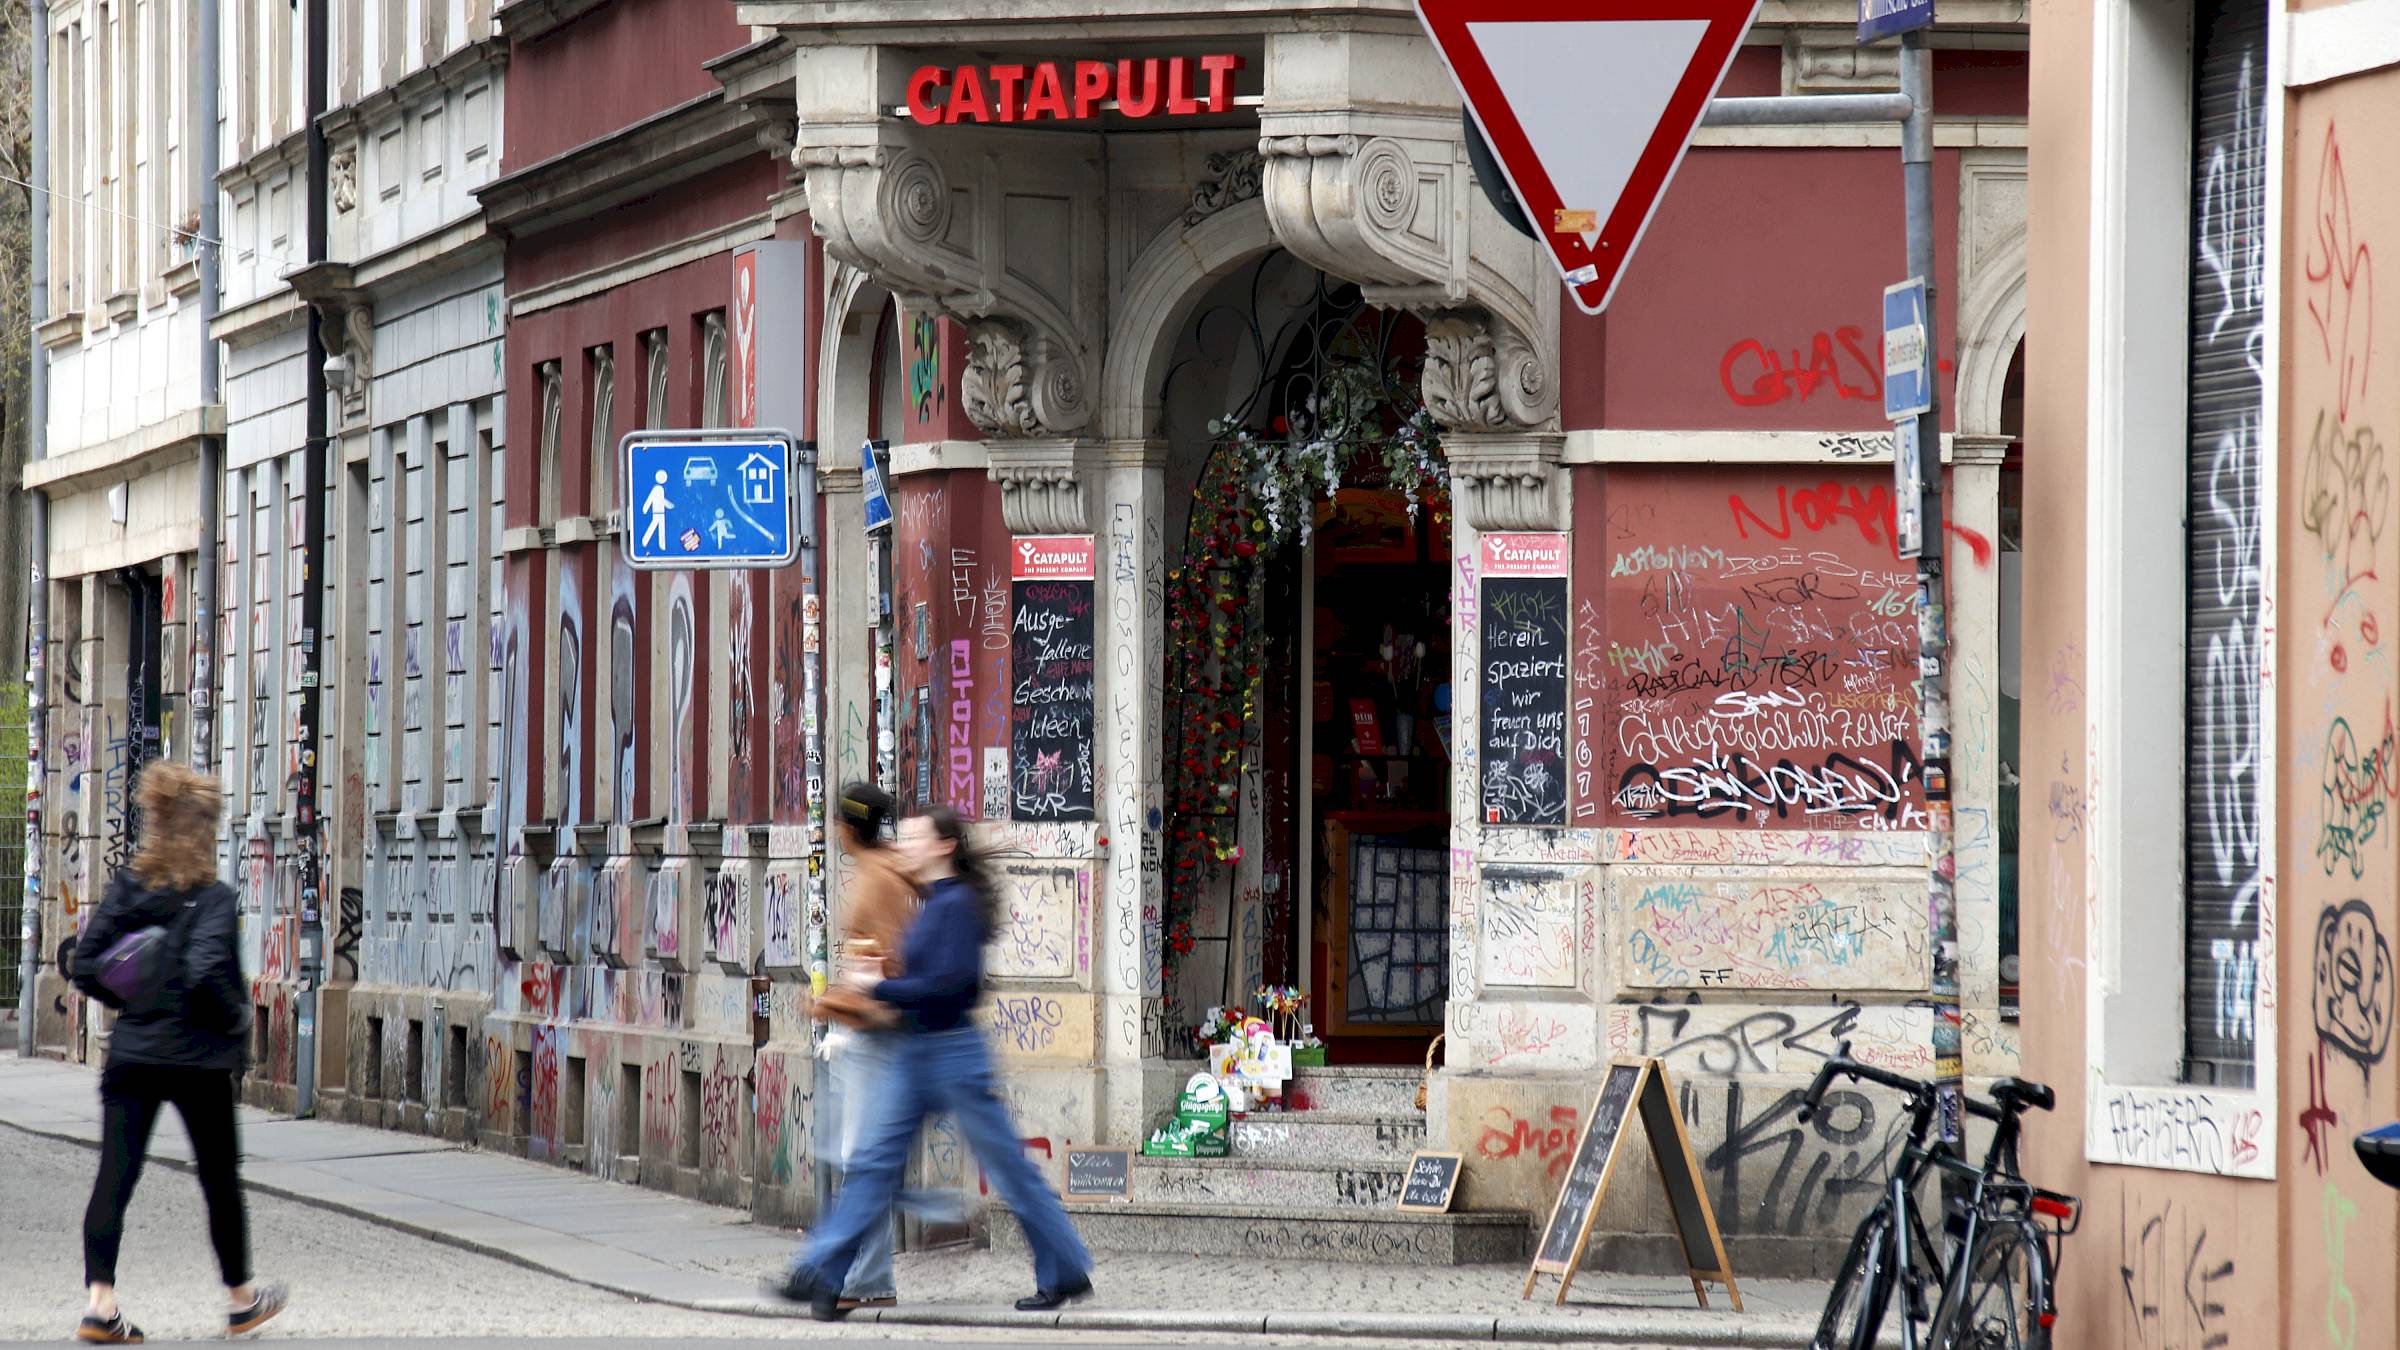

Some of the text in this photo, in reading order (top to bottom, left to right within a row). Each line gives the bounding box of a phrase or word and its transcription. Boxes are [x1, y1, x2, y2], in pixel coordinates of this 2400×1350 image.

[906, 54, 1246, 126] CATAPULT
[1033, 551, 1088, 565] CATAPULT
[1503, 549, 1561, 561] CATAPULT
[1511, 689, 1541, 708] wir
[1536, 711, 1564, 731] uns
